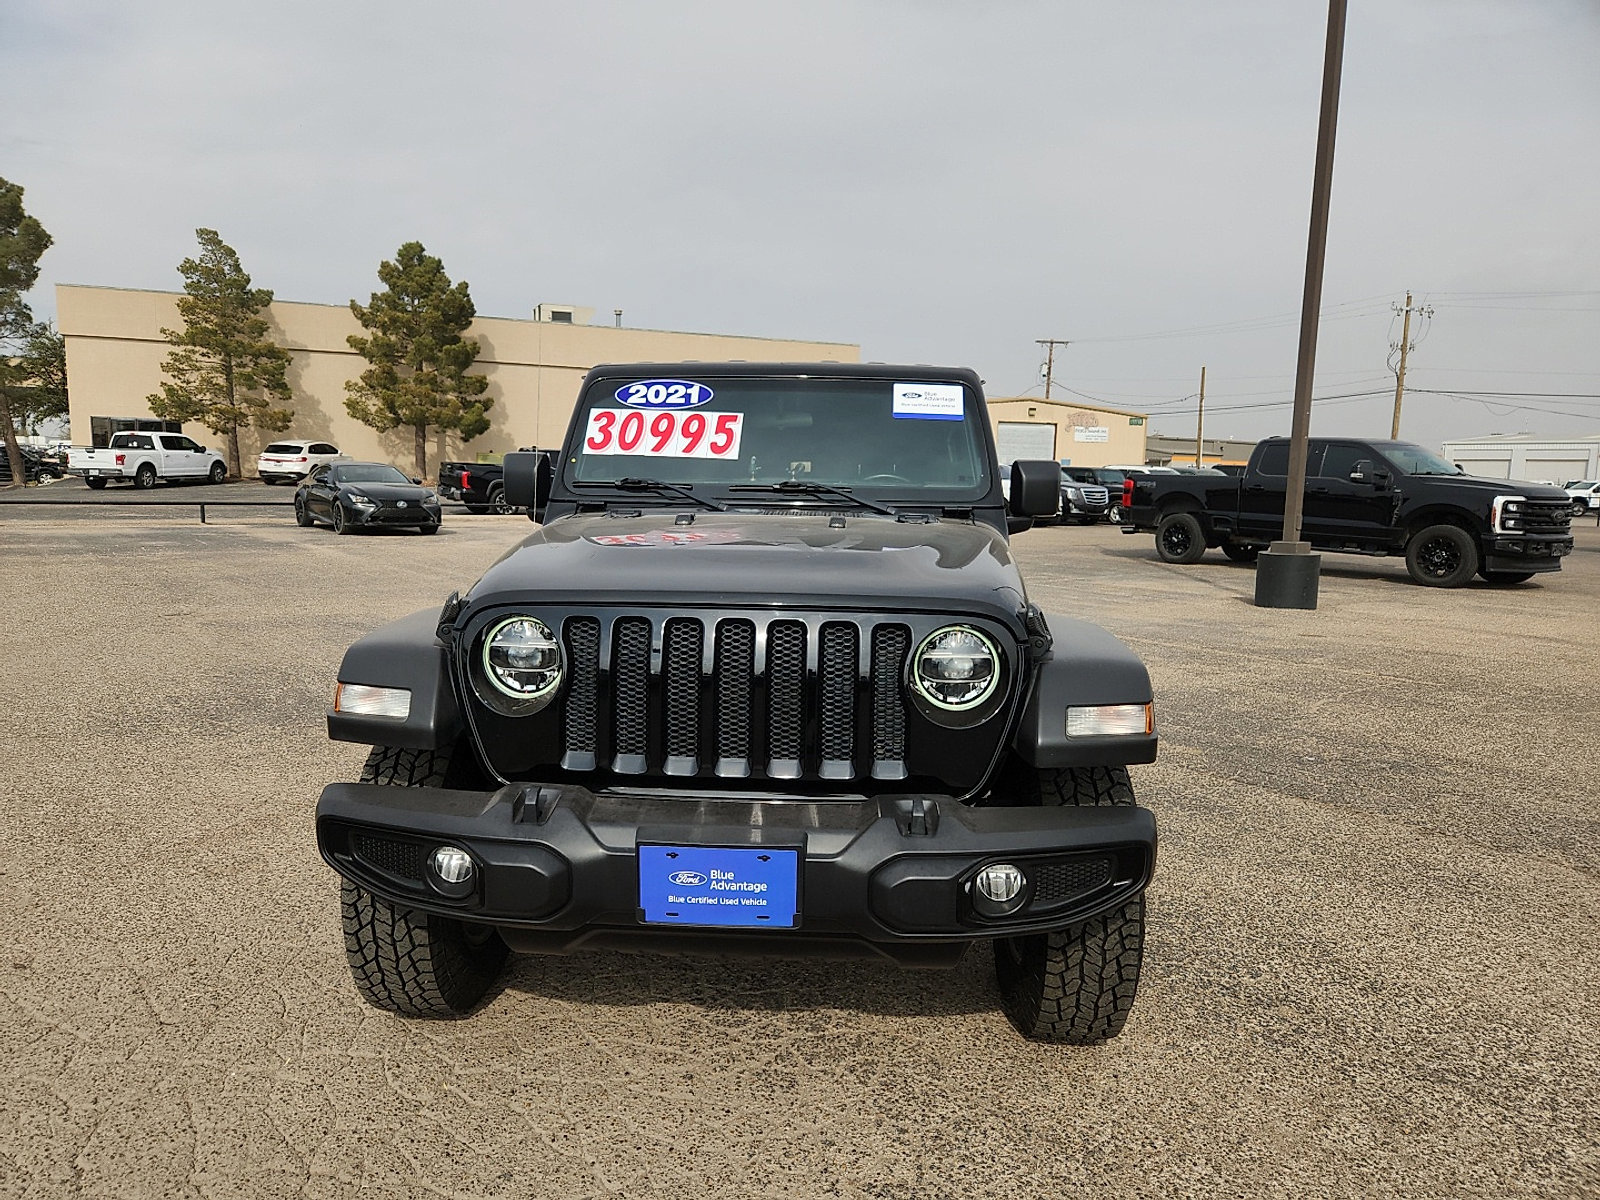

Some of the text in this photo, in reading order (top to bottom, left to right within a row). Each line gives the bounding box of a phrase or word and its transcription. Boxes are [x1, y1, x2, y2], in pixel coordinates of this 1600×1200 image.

[626, 384, 701, 404] 2021
[585, 411, 739, 455] 30995
[675, 872, 700, 884] Ford
[710, 869, 735, 880] Blue
[709, 880, 768, 893] Advantage
[668, 895, 767, 906] Blue Certified Used Vehicle
